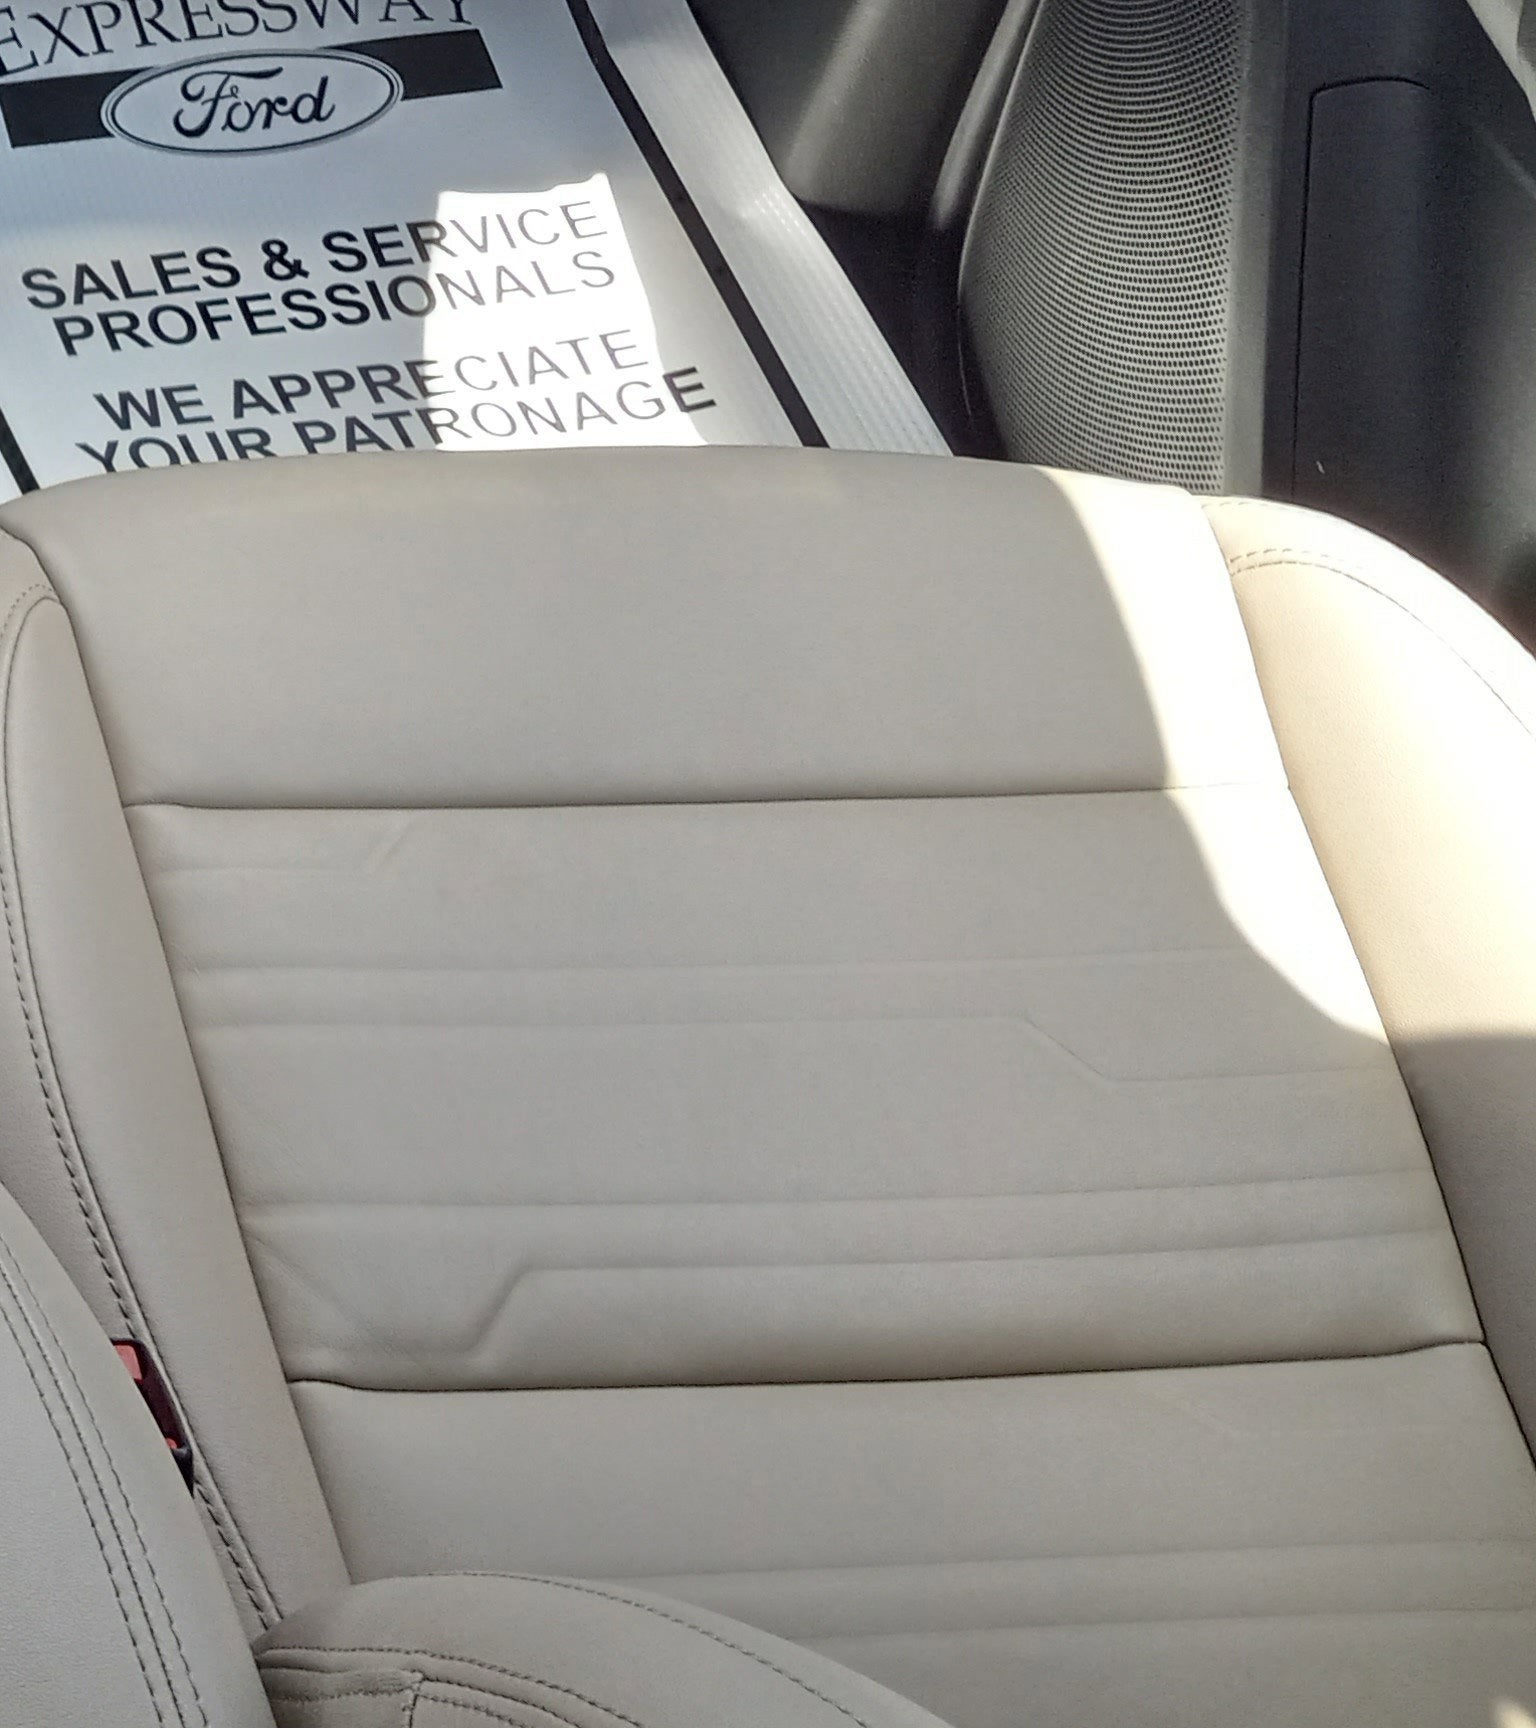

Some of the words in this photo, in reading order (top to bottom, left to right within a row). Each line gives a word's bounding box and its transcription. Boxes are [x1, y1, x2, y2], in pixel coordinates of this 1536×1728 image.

[172, 66, 336, 139] Ford
[22, 246, 243, 310] SALES
[260, 238, 310, 280] &
[321, 200, 609, 273] SERVICE
[52, 250, 617, 356] PROFESSIONALS
[92, 382, 214, 432] WE
[230, 328, 650, 420] APPRECIATE
[292, 366, 719, 456] PATRONAGE
